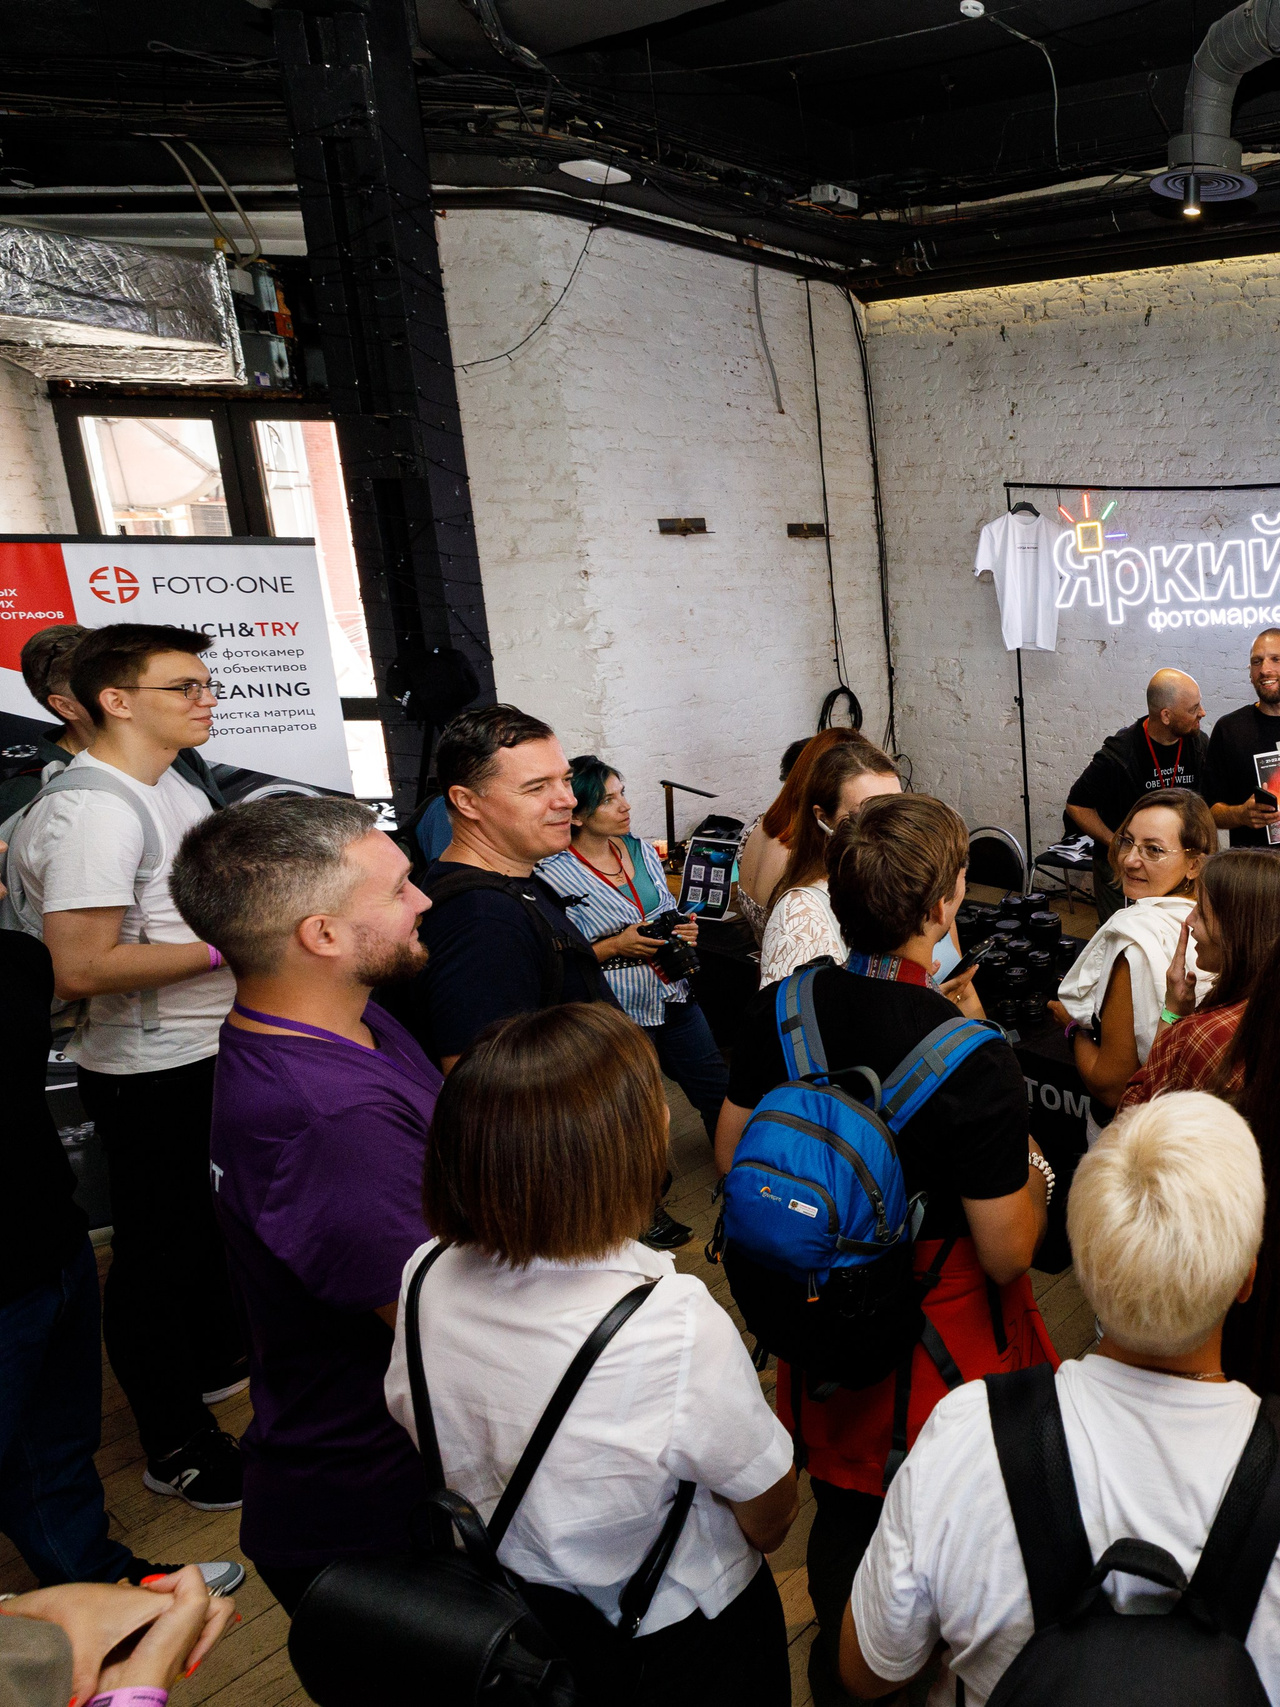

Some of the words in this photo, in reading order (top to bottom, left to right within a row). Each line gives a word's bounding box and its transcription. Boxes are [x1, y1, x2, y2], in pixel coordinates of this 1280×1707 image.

[0, 610, 65, 620] ОГРАФОВ
[222, 648, 305, 660] фотокамер
[223, 664, 307, 675] объективов
[211, 711, 260, 720] чистка
[264, 708, 316, 719] матриц
[208, 723, 318, 737] фотоаппаратов
